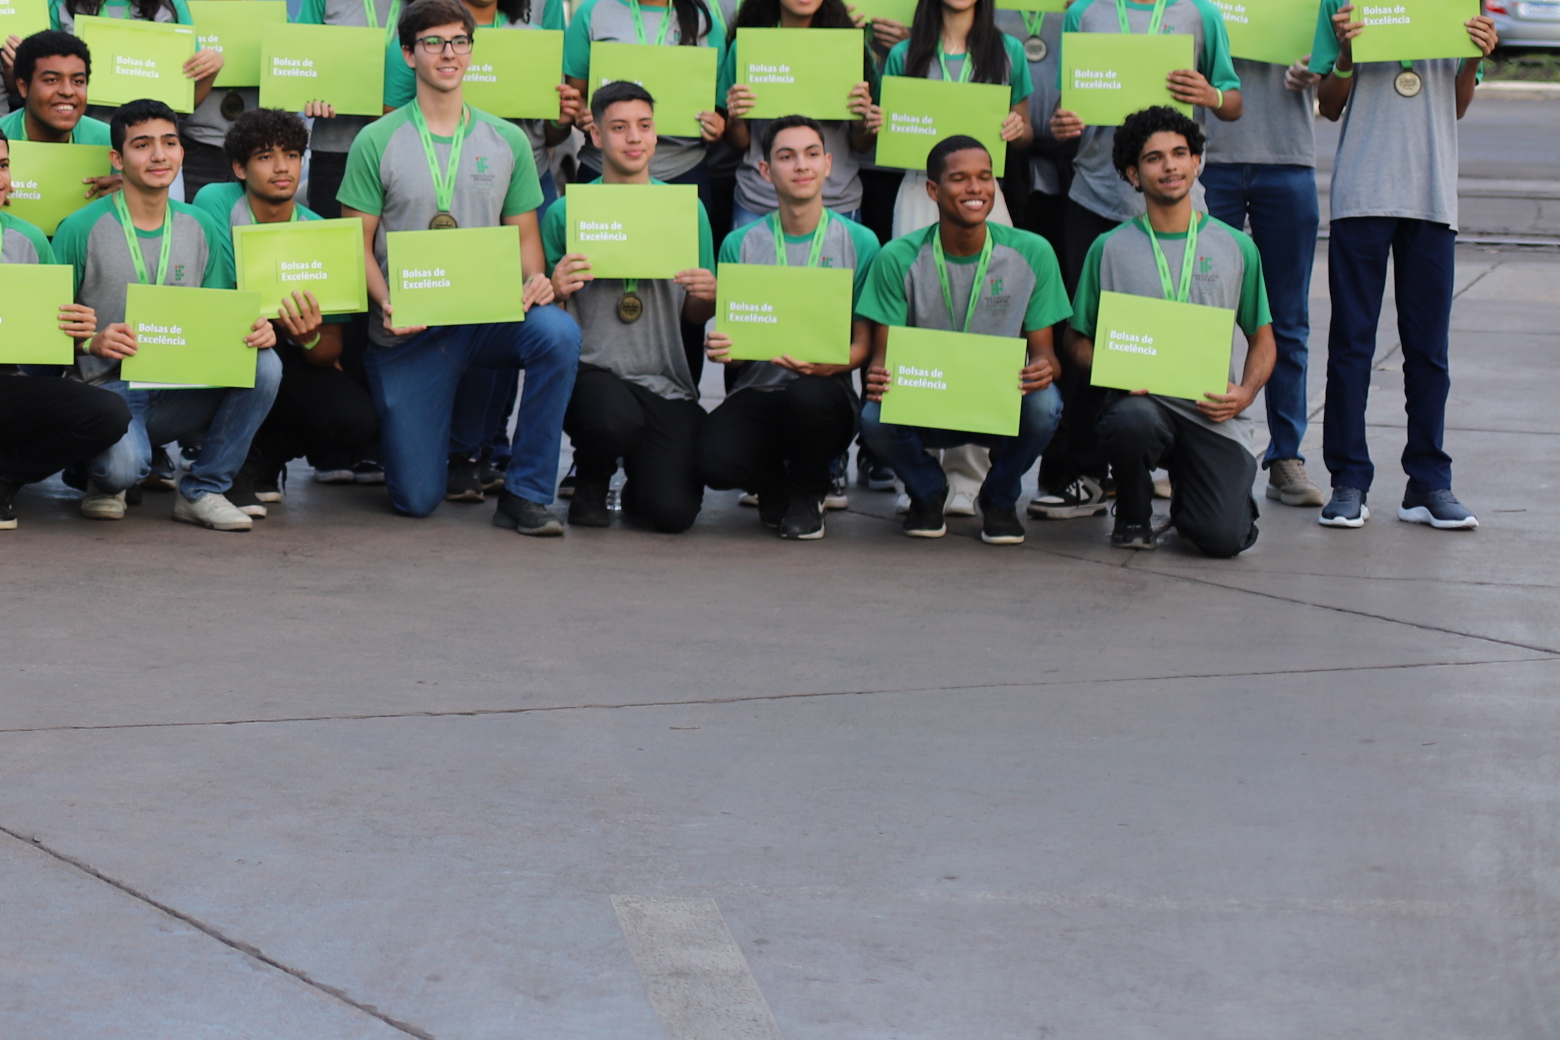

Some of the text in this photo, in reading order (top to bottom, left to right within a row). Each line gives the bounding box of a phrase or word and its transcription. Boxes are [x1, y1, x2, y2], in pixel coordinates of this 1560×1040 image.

[1234, 3, 1246, 13] de
[1363, 5, 1405, 15] Bolsas de
[1362, 15, 1410, 25] Excelência
[208, 34, 219, 43] de
[117, 56, 156, 67] Bolsas de
[274, 57, 313, 67] Bolsas de
[116, 66, 159, 78] Excelência
[273, 67, 317, 77] Excelência
[482, 63, 493, 72] de
[749, 64, 790, 72] Bolsas de
[749, 74, 794, 83] Excelência
[1075, 69, 1117, 78] Bolsas de
[1075, 80, 1121, 89] Excelência
[892, 113, 933, 124] Bolsas de
[891, 123, 937, 135] Excelência
[26, 180, 38, 189] de
[580, 221, 622, 230] Bolsas de
[580, 232, 627, 240] Excelência
[281, 260, 322, 270] Bolsas de
[282, 271, 327, 281] Excelência
[403, 268, 445, 278] Bolsas de
[403, 278, 450, 289] Excelência
[730, 302, 773, 312] Bolsas de
[730, 313, 777, 323] Excelência
[139, 323, 182, 334] Bolsas de
[138, 334, 186, 345] Excelência
[1110, 330, 1153, 344] Bolsas de
[1109, 341, 1156, 355] Excelência
[899, 365, 943, 378] Bolsas de
[898, 377, 947, 390] Excelência
